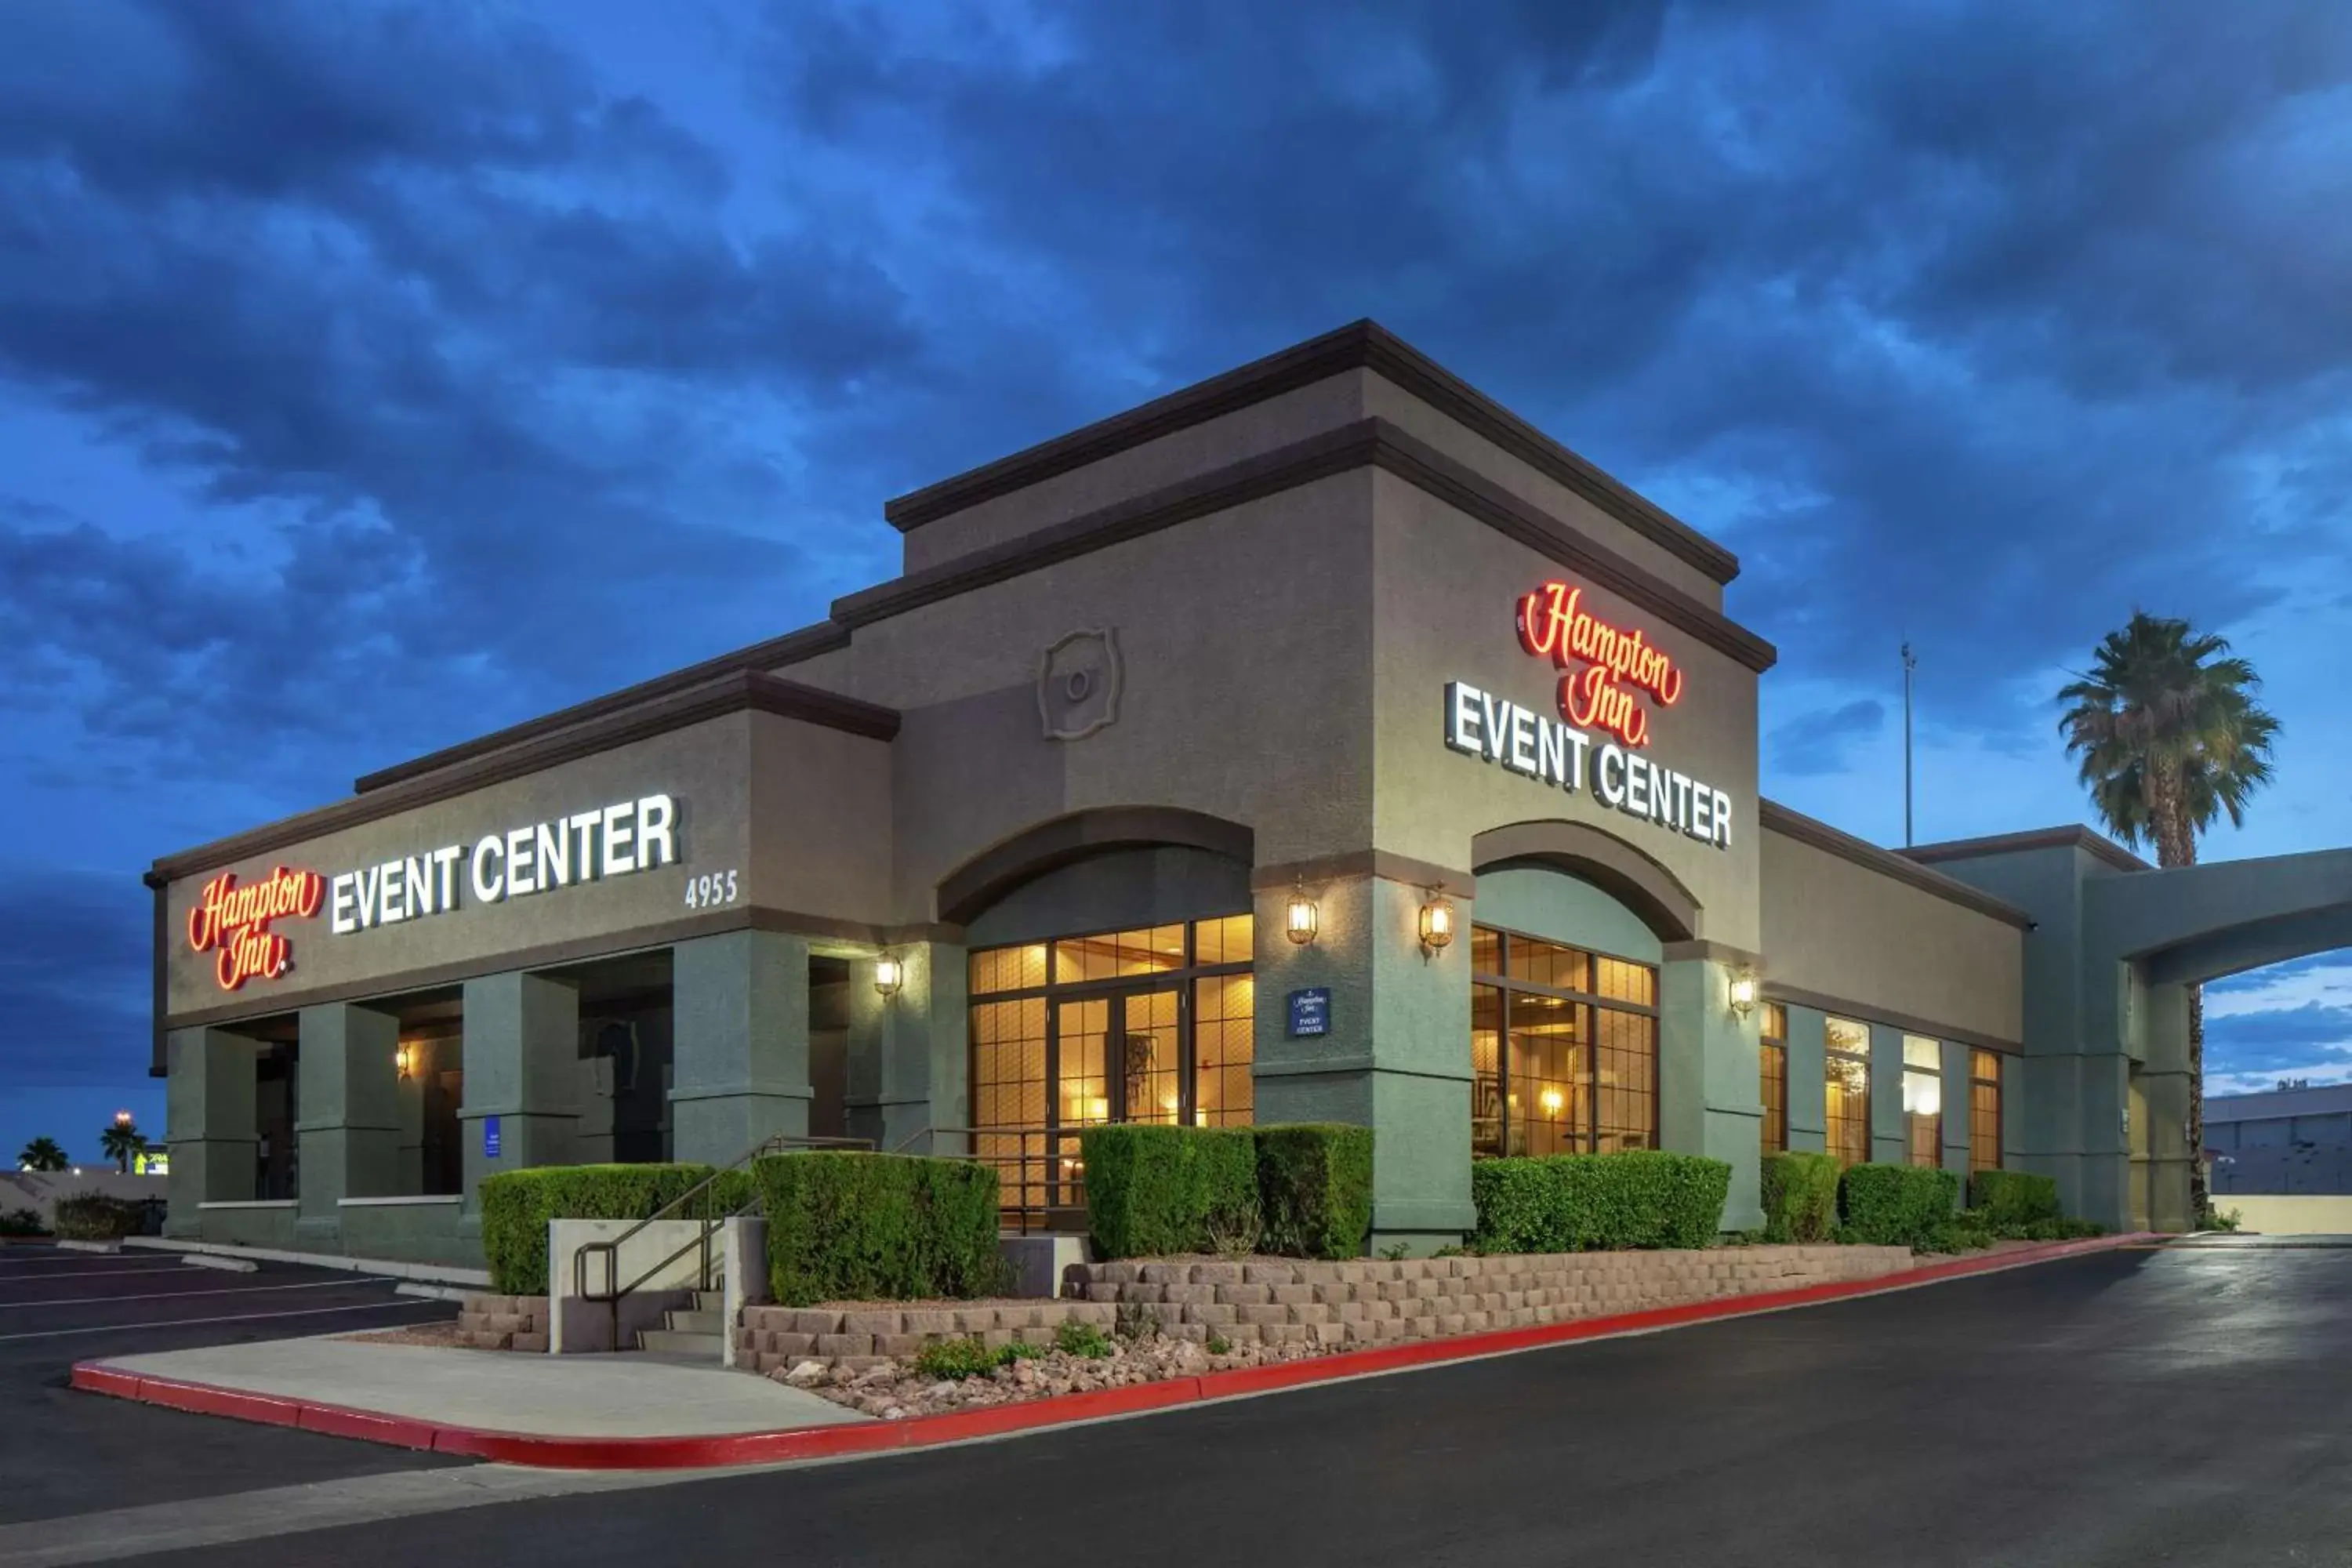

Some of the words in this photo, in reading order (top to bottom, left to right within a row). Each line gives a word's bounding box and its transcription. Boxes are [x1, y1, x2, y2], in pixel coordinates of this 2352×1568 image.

[1526, 583, 1682, 705] Hampton
[1567, 666, 1647, 745] Inn
[1455, 681, 1589, 790] EVENT
[1599, 743, 1732, 846] CENTER
[332, 844, 461, 935] EVENT
[472, 793, 675, 903] CENTER
[684, 869, 739, 909] 4955
[188, 866, 320, 951] Hampton
[217, 924, 285, 990] Inn
